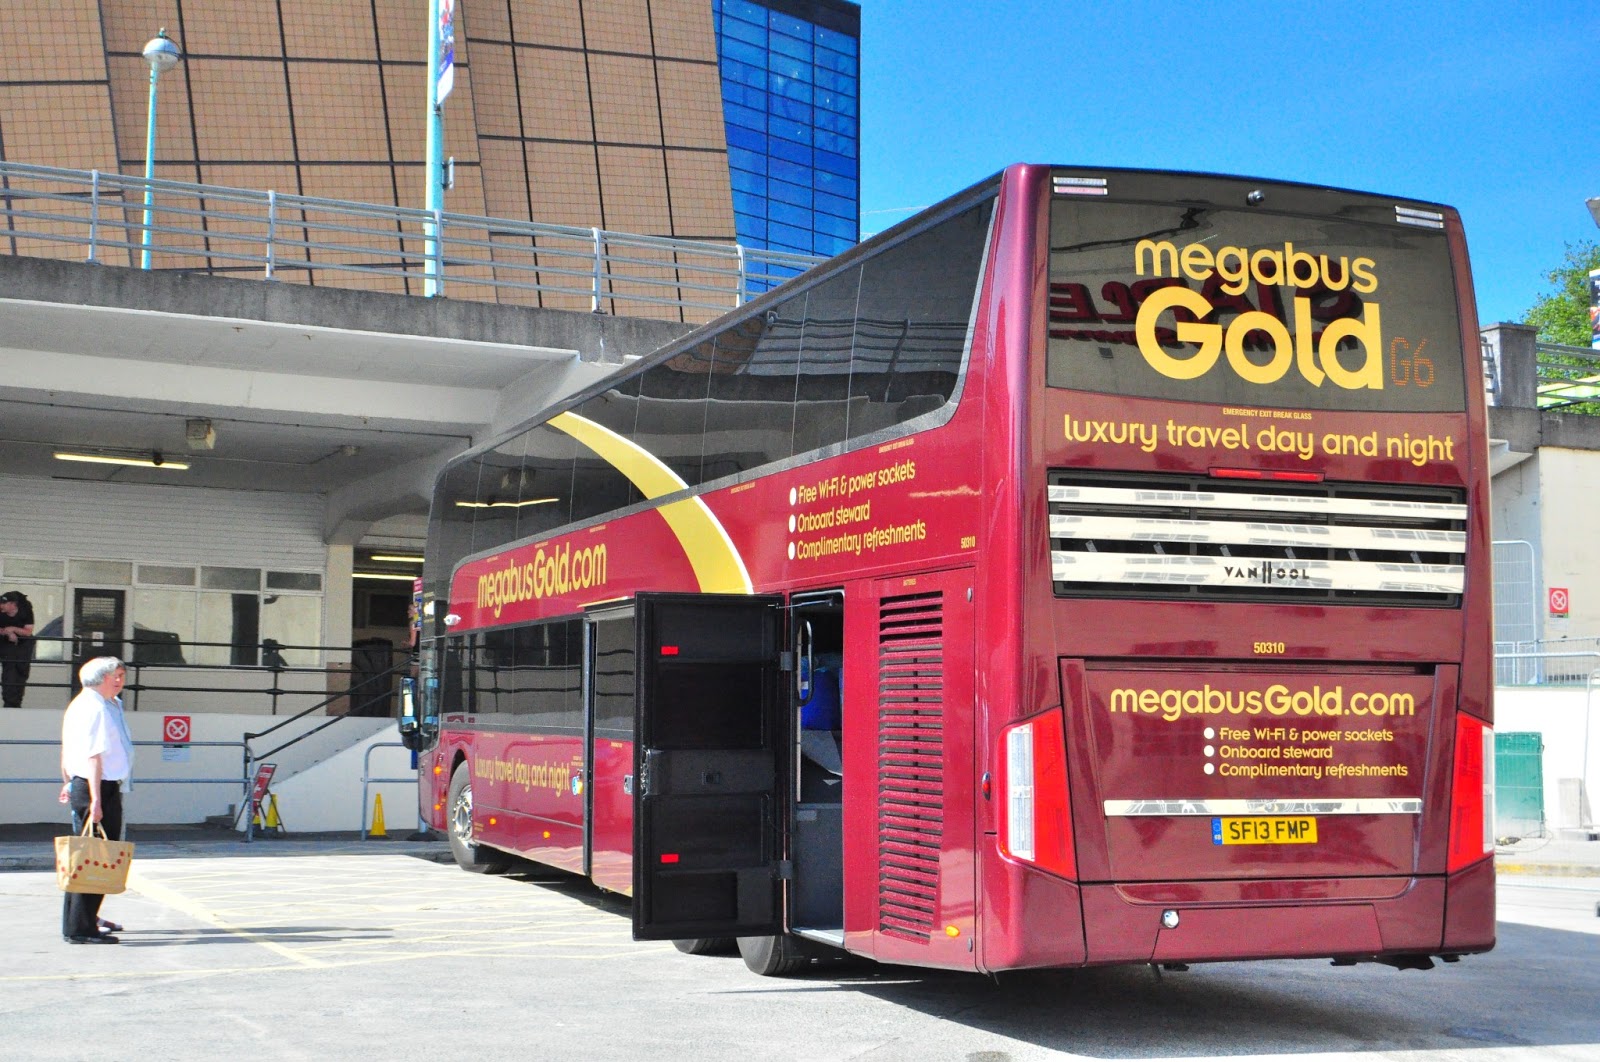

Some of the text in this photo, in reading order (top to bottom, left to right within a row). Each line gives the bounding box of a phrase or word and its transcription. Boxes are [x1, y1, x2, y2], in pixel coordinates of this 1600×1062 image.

[1134, 239, 1379, 296] megabus
[1135, 286, 1384, 389] Gold
[1391, 335, 1434, 388] G6
[1222, 407, 1312, 420] EMERGENCY EXIT BREAK GLASS
[1064, 414, 1454, 467] luxury travel day and night
[798, 459, 916, 504] Free Wi-Fi & power sockets
[797, 499, 870, 533] Onboard steward
[797, 519, 926, 561] Complimentary refreshments
[477, 542, 607, 618] megabusGold.com
[1253, 641, 1285, 655] 50310
[1110, 684, 1415, 721] megabusGold.com
[1219, 727, 1394, 744] Free Wi-Fi & power sockets
[1219, 745, 1333, 759] Onboard steward
[548, 760, 570, 798] night
[1219, 763, 1408, 779] Complimentary refreshments
[1229, 820, 1310, 840] SF13 FMP
